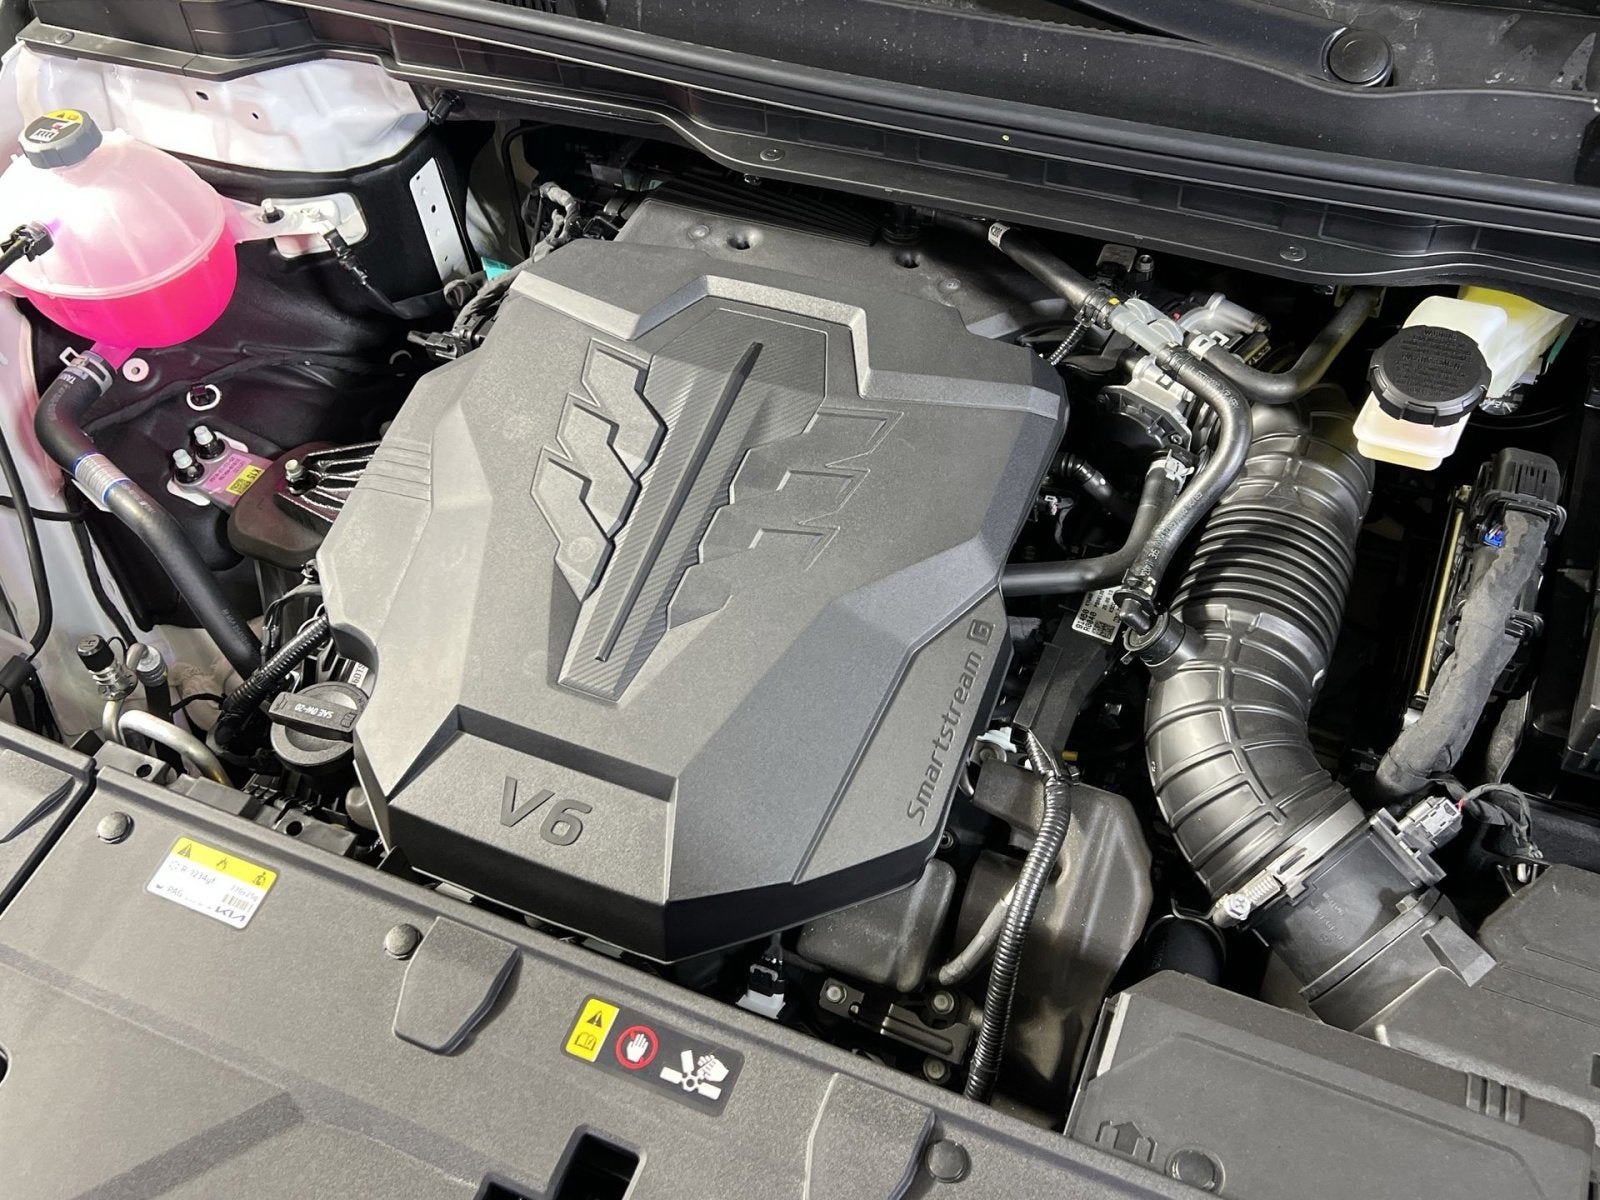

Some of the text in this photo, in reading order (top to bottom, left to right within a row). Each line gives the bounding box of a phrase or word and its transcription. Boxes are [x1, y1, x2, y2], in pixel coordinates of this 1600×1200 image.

[294, 703, 335, 719] SAE 0W-20
[906, 650, 984, 827] Smartstream
[500, 776, 593, 847] V6
[215, 905, 246, 922] KIA
